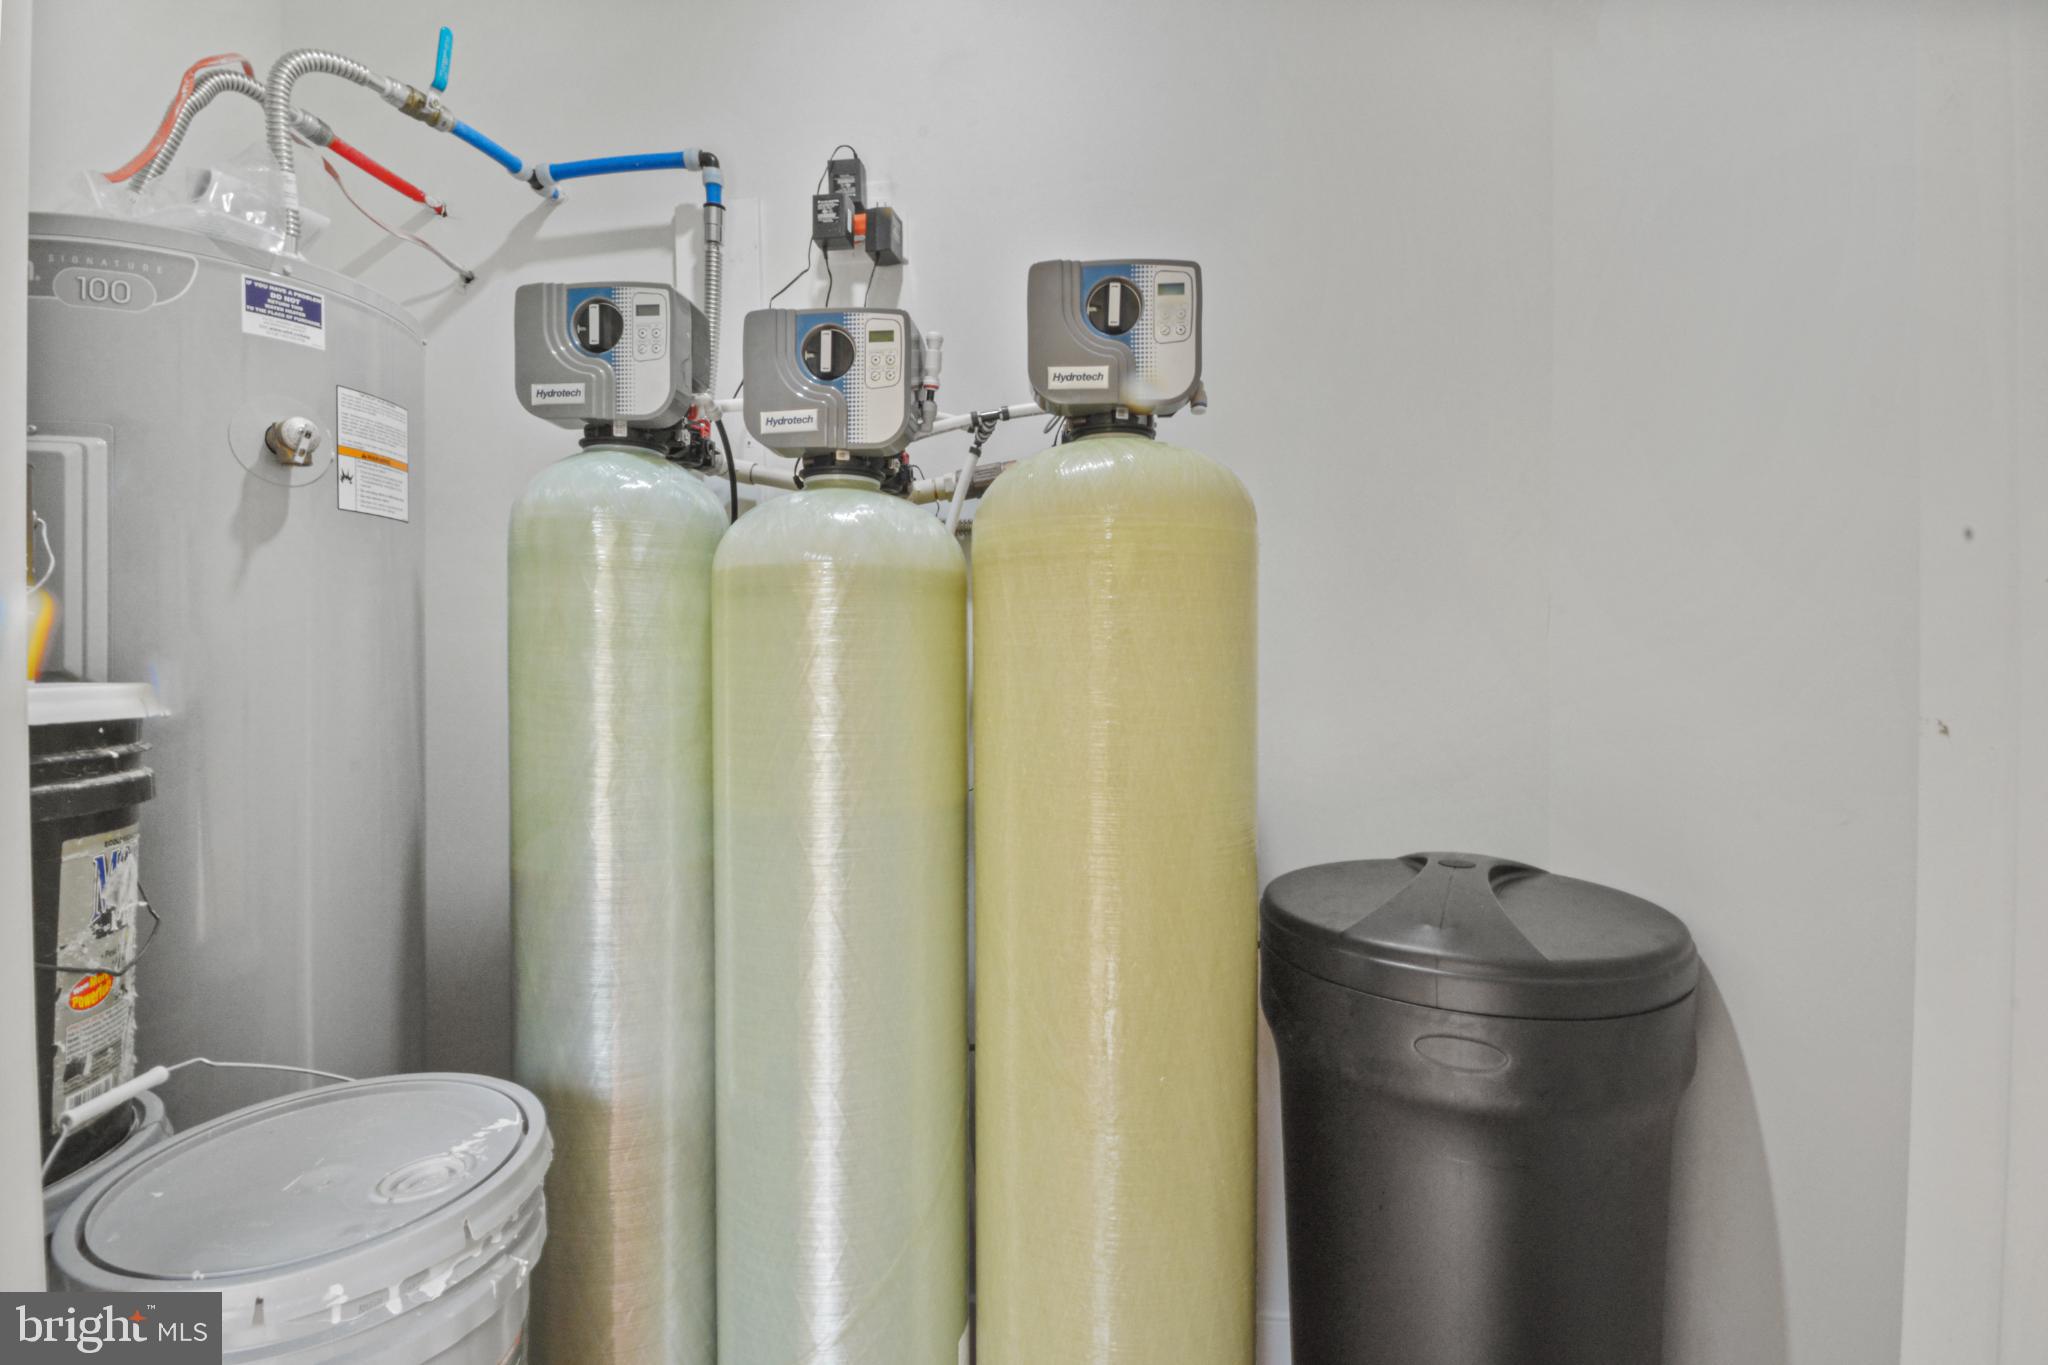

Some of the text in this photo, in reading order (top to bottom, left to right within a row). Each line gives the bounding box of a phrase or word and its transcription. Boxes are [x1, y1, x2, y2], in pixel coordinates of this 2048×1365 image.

[48, 254, 163, 274] SIGNATURE
[76, 275, 132, 304] 100
[269, 285, 287, 294] HAVE
[294, 293, 322, 303] PROBLEM
[267, 298, 290, 308] RETURN
[270, 292, 301, 304] DO NOT
[264, 303, 306, 317] WATER HEATER
[268, 309, 285, 318] PLACE
[1052, 372, 1104, 384] Hydrotech
[535, 388, 582, 400] Hydrotech
[765, 415, 814, 427] Hydrotech
